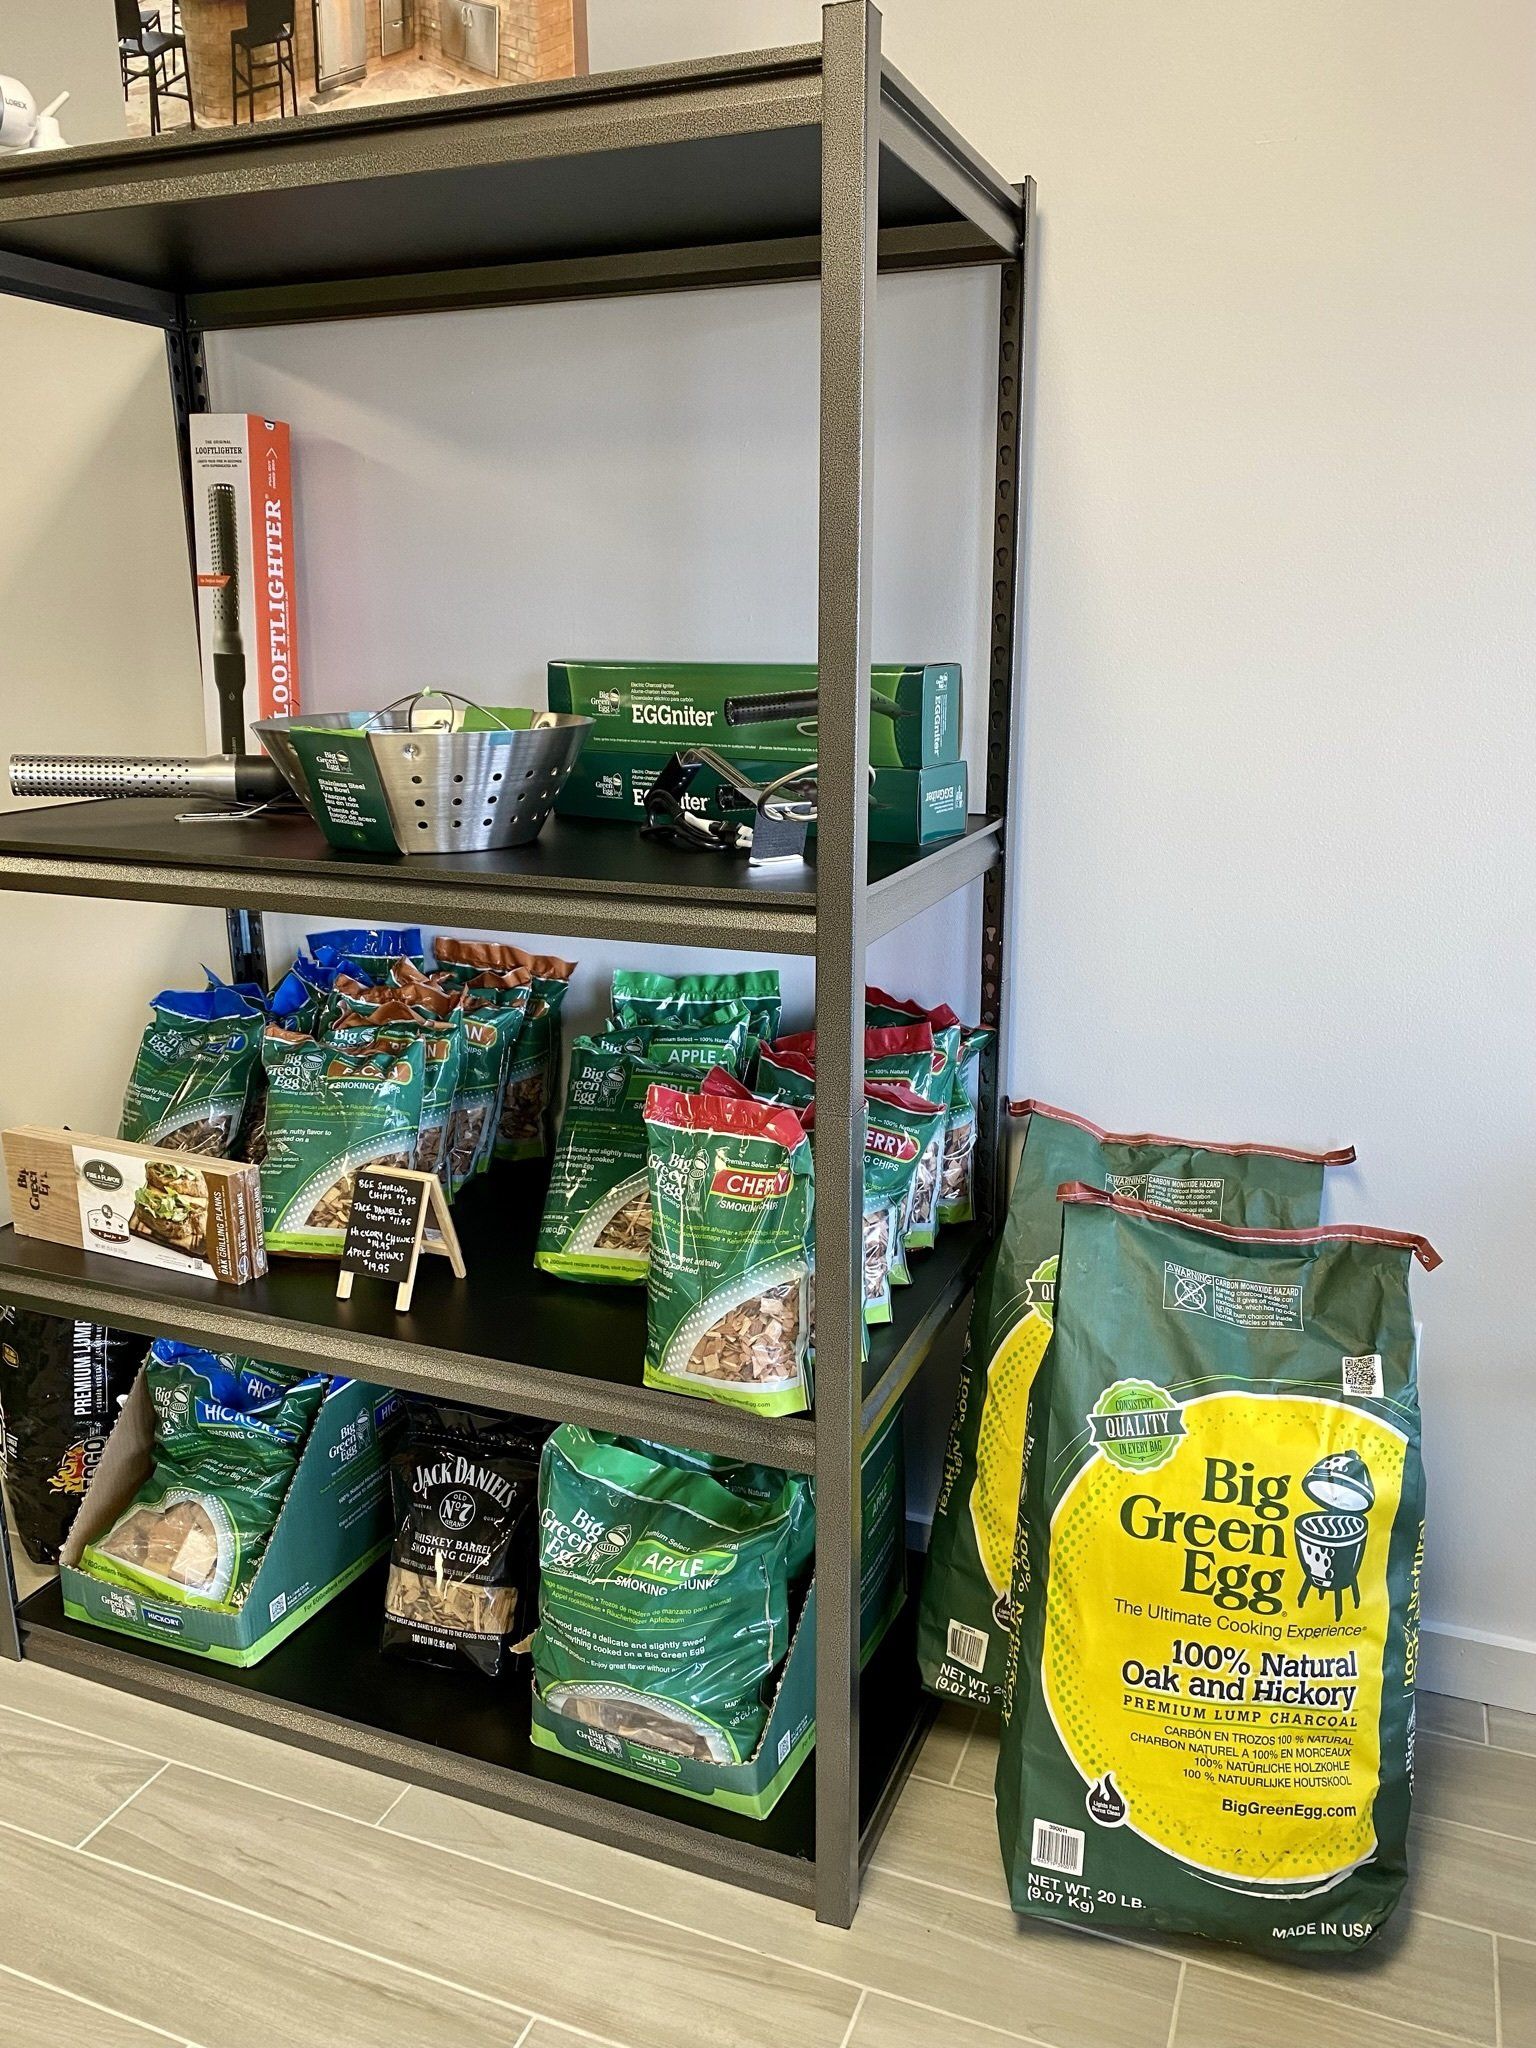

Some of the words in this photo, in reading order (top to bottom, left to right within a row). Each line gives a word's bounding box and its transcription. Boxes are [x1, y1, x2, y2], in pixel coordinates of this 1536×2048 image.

[5, 97, 28, 110] LOREX
[195, 446, 242, 455] LOOFTLIGHTER
[264, 499, 289, 720] LOOFTLIGHTER
[590, 698, 610, 706] Green
[599, 690, 610, 700] Big
[598, 705, 610, 714] Egg
[631, 704, 714, 727] EGGniter
[316, 756, 339, 765] Green
[318, 778, 348, 788] Stainless
[348, 781, 366, 790] Steel
[335, 786, 350, 794] Bowl
[926, 786, 954, 802] EGGniter
[334, 1029, 358, 1043] Big
[601, 1041, 623, 1054] Big
[667, 1048, 716, 1064] APPLE
[283, 1053, 303, 1066] Big
[273, 1075, 301, 1089] Egg
[582, 1066, 605, 1083] Big
[336, 1082, 375, 1091] SMOKING
[573, 1089, 598, 1105] Egg
[668, 1152, 693, 1174] Big
[724, 1158, 751, 1167] Premium
[751, 1161, 769, 1169] Select
[872, 1158, 900, 1172] CHIPS
[358, 1179, 375, 1189] BGE
[1113, 1176, 1147, 1186] WARNING
[1148, 1176, 1171, 1185] CARBON
[1171, 1179, 1199, 1188] MONOXIDE
[1199, 1180, 1221, 1189] HAZARD
[213, 1191, 224, 1222] PLANKS
[236, 1192, 246, 1215] PLANKS
[368, 1190, 392, 1201] CHIPS
[396, 1192, 417, 1206] $7.95
[353, 1202, 372, 1212] JACK
[374, 1205, 403, 1216] DANIELS
[239, 1215, 248, 1241] GRILLING
[366, 1213, 386, 1222] CHIPS
[389, 1216, 412, 1226] $11.95
[216, 1223, 228, 1258] GRILLING
[350, 1226, 383, 1240] HICKORY
[385, 1232, 415, 1245] CHUNKS
[367, 1238, 391, 1250] $14.95
[346, 1246, 371, 1258] APPLE
[375, 1251, 405, 1262] CHUNKS
[220, 1259, 229, 1275] OAK
[363, 1259, 390, 1274] $19.95
[1173, 1264, 1213, 1284] WARNING
[1215, 1278, 1239, 1289] CARBON
[1240, 1282, 1273, 1295] MONOXIDE
[1273, 1287, 1299, 1297] HAZARD
[1215, 1285, 1235, 1297] Burning
[1263, 1294, 1281, 1302] inside
[1215, 1305, 1233, 1315] NEVER
[1233, 1311, 1247, 1319] burn
[1275, 1314, 1293, 1322] inside
[74, 1354, 92, 1416] PREMIUM
[155, 1386, 172, 1405] Big
[1115, 1396, 1155, 1412] CONSISTENT
[340, 1421, 356, 1440] Big
[1104, 1412, 1172, 1438] QUALITY
[329, 1434, 357, 1459] Green
[340, 1442, 358, 1462] Egg
[1118, 1442, 1128, 1454] IN
[1128, 1440, 1148, 1453] EVERY
[1149, 1439, 1163, 1452] BAG
[412, 1462, 453, 1494] JACK
[454, 1456, 518, 1509] DANIEL'S
[1201, 1457, 1292, 1521] Big
[453, 1493, 468, 1501] OLD
[540, 1508, 593, 1555] Green
[570, 1507, 606, 1543] Big
[1120, 1494, 1288, 1559] Green
[455, 1540, 491, 1555] BARREL
[544, 1536, 583, 1567] Egg
[668, 1538, 690, 1552] Select
[459, 1552, 490, 1567] CHIPS
[641, 1552, 704, 1578] APPLE
[1018, 1530, 1033, 1592] 100%
[1180, 1548, 1286, 1616] Egg
[101, 1595, 125, 1610] Green
[110, 1591, 123, 1603] Big
[111, 1606, 126, 1618] Egg
[147, 1612, 180, 1627] HICKORY
[1113, 1597, 1143, 1617] The
[1147, 1604, 1212, 1628] Ultimate
[1216, 1614, 1283, 1642] Cooking
[1286, 1624, 1362, 1641] Experience
[556, 1618, 572, 1631] wood
[573, 1626, 592, 1638] adds
[592, 1632, 598, 1640] a
[598, 1633, 629, 1648] delicate
[630, 1642, 647, 1650] and
[648, 1640, 681, 1651] slightly
[681, 1635, 707, 1647] sweet
[1172, 1638, 1252, 1677] 100%
[1259, 1650, 1358, 1678] Natural
[935, 1675, 967, 1697] (9.07
[940, 1662, 967, 1683] NET
[968, 1675, 990, 1694] WT.
[1121, 1659, 1180, 1693] Oak
[1187, 1677, 1246, 1702] and
[1250, 1679, 1357, 1712] Hickory
[1123, 1693, 1207, 1719] PREMIUM
[1214, 1708, 1262, 1723] LUMP
[1269, 1711, 1358, 1728] CHARCOAL
[576, 1729, 607, 1747] Green
[588, 1727, 605, 1739] Big
[1163, 1724, 1211, 1741] CARBÓN
[1214, 1730, 1230, 1742] EN
[1232, 1732, 1276, 1745] TROZOS
[1277, 1734, 1292, 1745] 100
[1295, 1734, 1304, 1744] %
[1306, 1735, 1354, 1746] NATURAL
[589, 1740, 608, 1753] Egg
[1130, 1732, 1186, 1751] CHARBON
[1188, 1742, 1239, 1758] NATUREL
[1241, 1748, 1250, 1758] A
[1252, 1749, 1278, 1760] 100%
[1280, 1748, 1294, 1759] EN
[1295, 1747, 1352, 1759] MORCEAUX
[641, 1752, 667, 1766] APPLE
[1194, 1757, 1223, 1770] 100%
[1226, 1759, 1292, 1774] NATÜRLICHE
[1294, 1760, 1351, 1773] HOLZKOHLE
[1183, 1767, 1201, 1780] 100
[1204, 1770, 1215, 1782] %
[1218, 1773, 1291, 1789] NATUURLIJKE
[1293, 1775, 1353, 1788] HOUTSKOOL
[1093, 1800, 1108, 1809] Lights
[1109, 1803, 1120, 1811] Fast
[1221, 1798, 1357, 1820] BigGreenEgg.com
[1048, 1824, 1068, 1834] 390011
[1028, 1872, 1061, 1891] NET
[1064, 1881, 1093, 1900] WT.
[1097, 1889, 1117, 1905] 20
[1120, 1894, 1147, 1909] LB.
[1027, 1885, 1064, 1905] (9.07
[1068, 1896, 1095, 1914] Kg)
[1272, 1922, 1317, 1940] MADE
[1321, 1922, 1337, 1936] IN
[1342, 1922, 1374, 1938] USA
